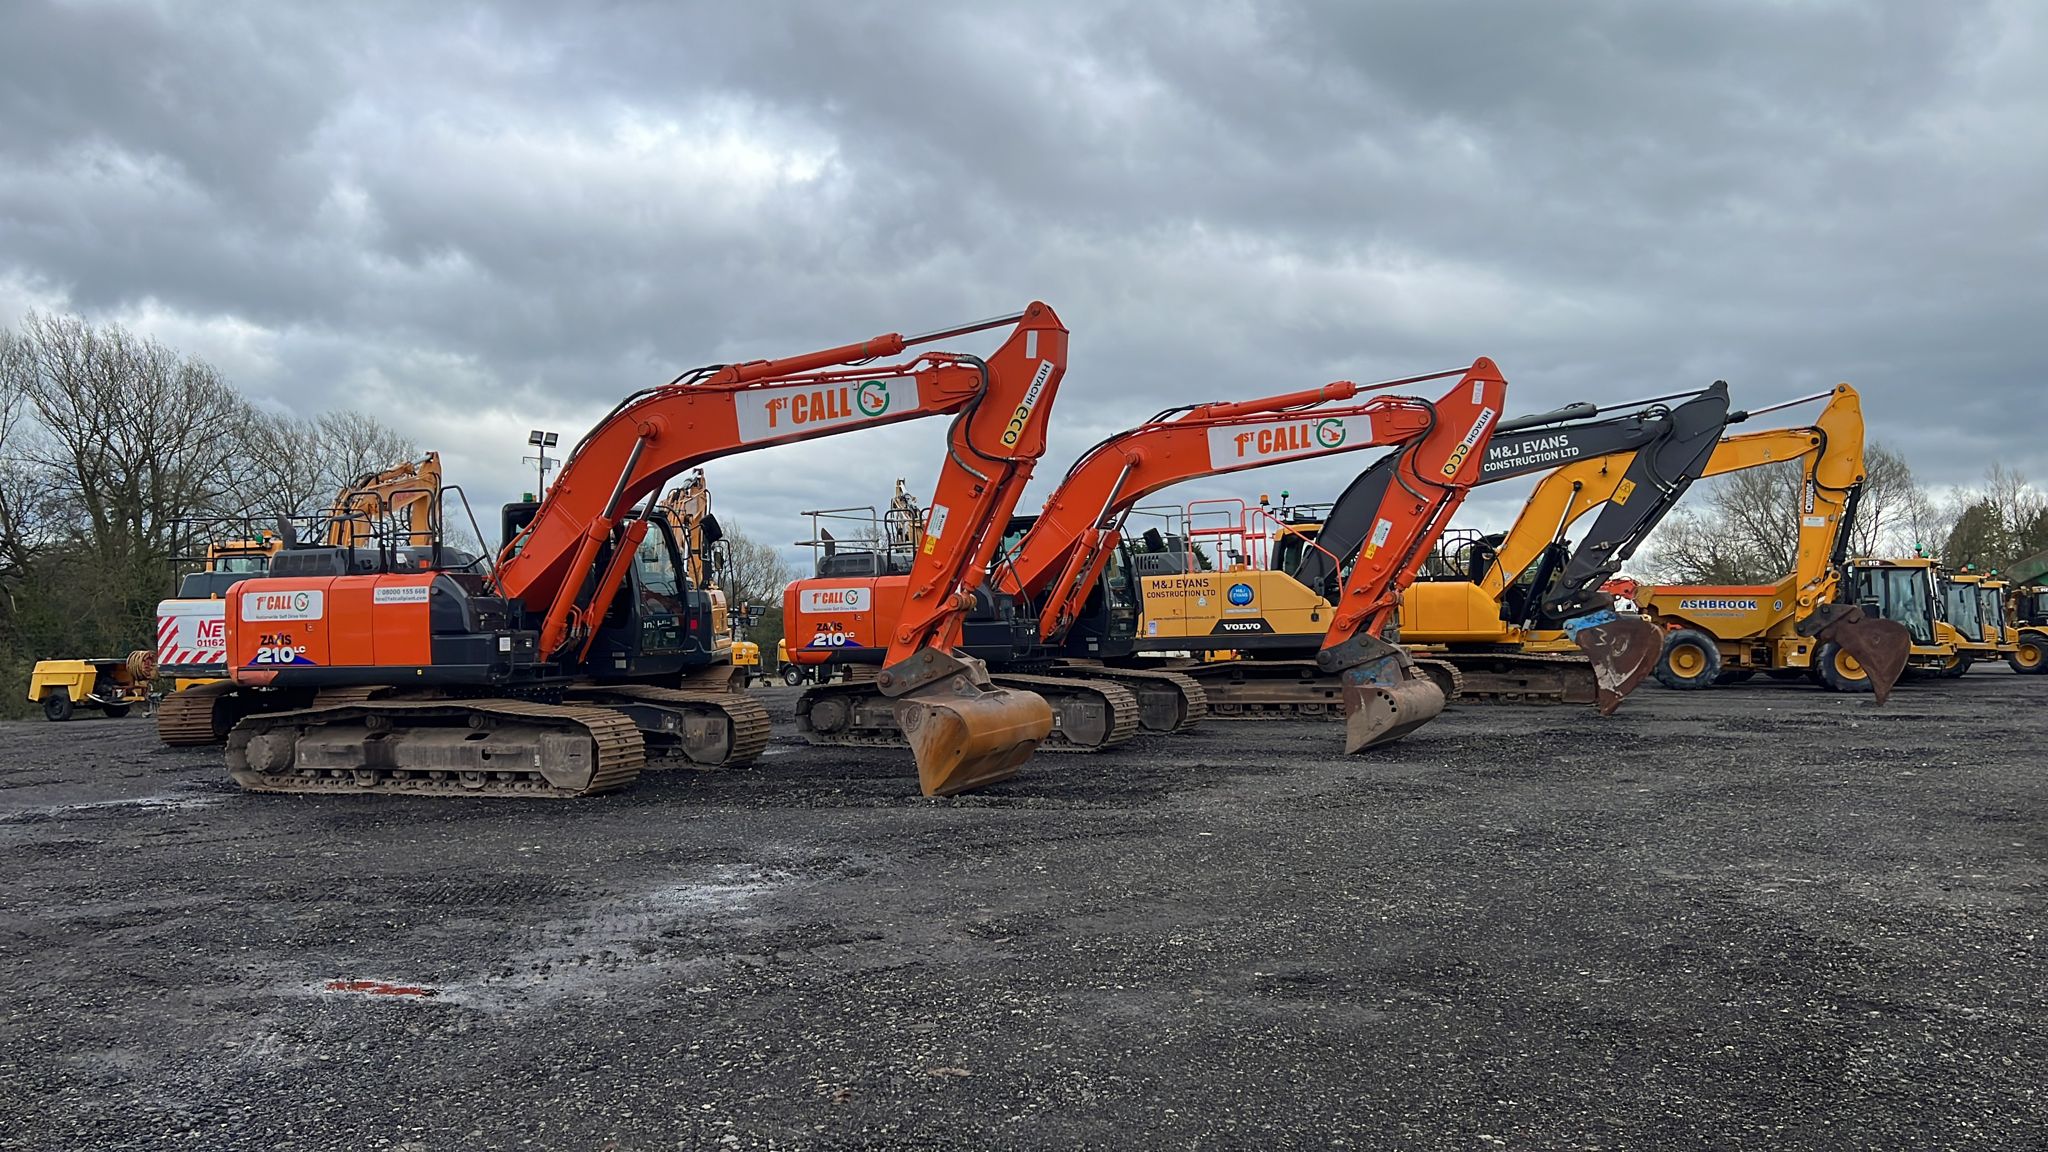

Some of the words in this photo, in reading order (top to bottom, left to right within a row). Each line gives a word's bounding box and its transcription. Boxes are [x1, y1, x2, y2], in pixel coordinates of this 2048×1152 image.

[1025, 363, 1051, 406] HITACHI
[765, 397, 789, 428] 1ST
[791, 387, 852, 425] CALL
[1003, 406, 1029, 445] eco
[1466, 410, 1492, 444] HITACHI
[1234, 431, 1255, 458] 1ST
[1257, 424, 1312, 454] CALL
[1489, 443, 1519, 460] M&J
[1522, 434, 1569, 454] EVANS
[1443, 443, 1468, 475] eco
[1483, 451, 1559, 472] CONSTRUCTION
[1560, 447, 1580, 458] LTD
[1152, 580, 1174, 590] M&J
[1176, 578, 1209, 588] EVANS
[821, 591, 844, 604] CALL
[1146, 590, 1201, 599] CONSTRUCTION
[1202, 589, 1216, 597] LTD
[266, 595, 292, 610] CALL
[1679, 599, 1759, 611] ASHBROOK
[817, 620, 843, 631] ZAXIS
[1223, 622, 1261, 631] VOLVO
[196, 638, 225, 647] 01162
[260, 632, 292, 646] ZAXIS
